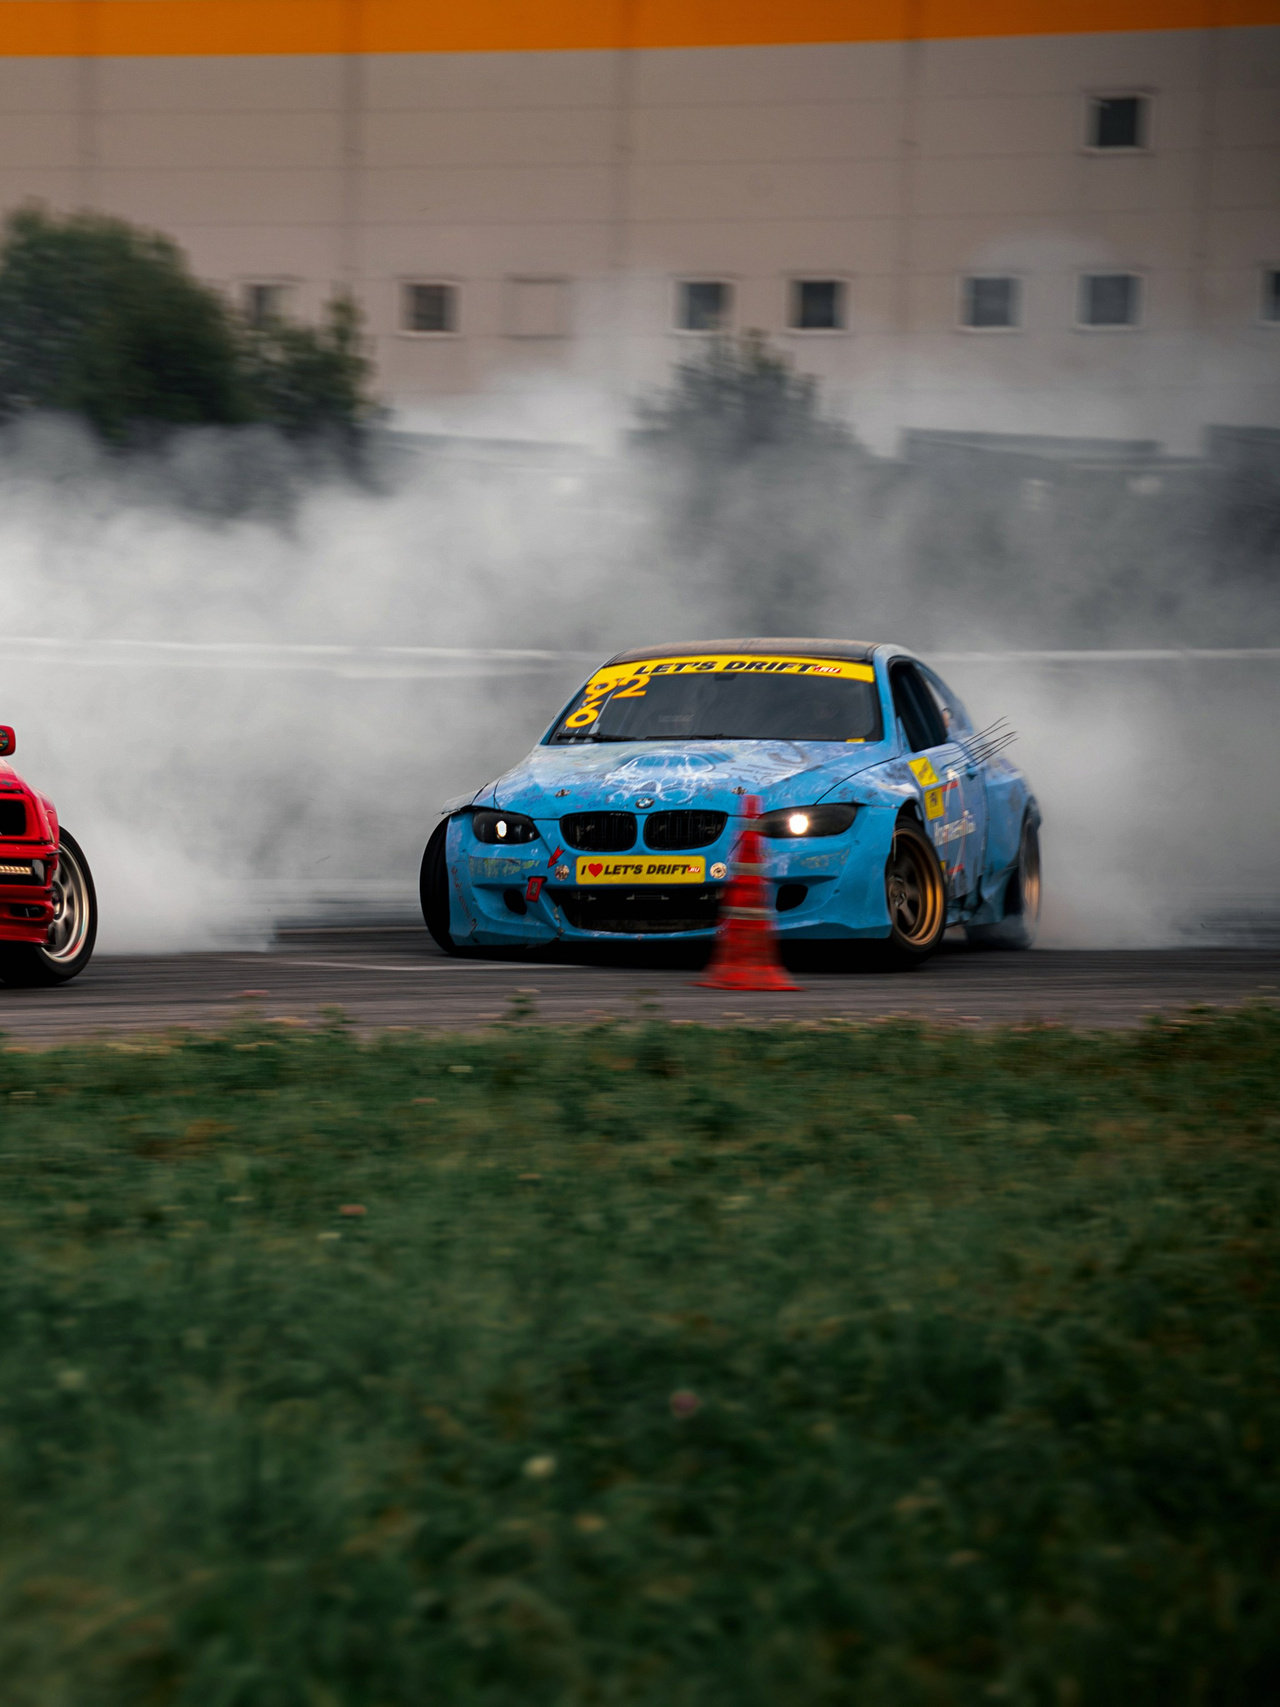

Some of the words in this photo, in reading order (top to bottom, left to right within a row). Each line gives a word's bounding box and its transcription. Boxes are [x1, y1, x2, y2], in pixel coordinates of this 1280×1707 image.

[634, 661, 720, 675] LET'S
[581, 865, 587, 875] I
[604, 863, 643, 875] LET'S
